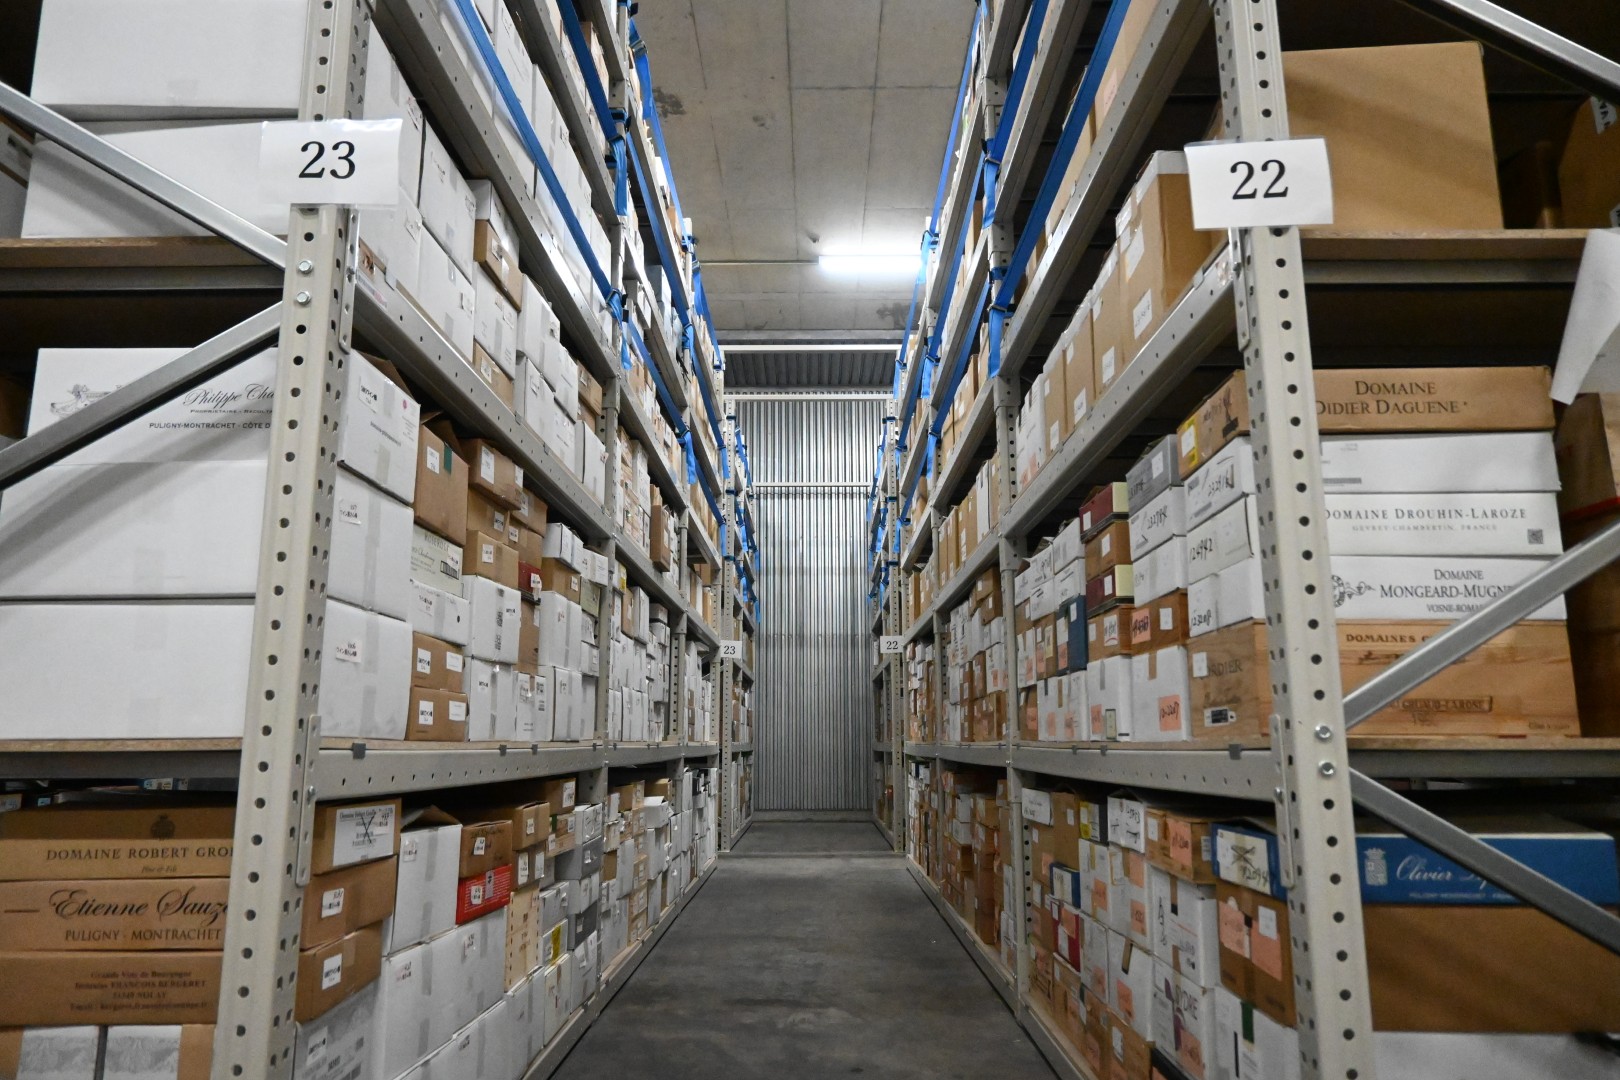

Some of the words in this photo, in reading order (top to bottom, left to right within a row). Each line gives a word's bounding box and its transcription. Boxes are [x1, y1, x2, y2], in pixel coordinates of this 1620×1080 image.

[299, 141, 356, 179] 23
[1229, 159, 1289, 200] 22
[1355, 381, 1436, 395] DOMAINE
[183, 388, 242, 409] Philippe
[1395, 508, 1527, 520] DROUHIN-LAROZE
[1434, 569, 1484, 580] DOMAINE
[886, 641, 898, 650] 22
[1345, 634, 1416, 643] DOMAINES
[724, 646, 735, 655] 23
[46, 848, 121, 861] DOMAINE
[128, 847, 189, 859] ROBERT
[1396, 855, 1453, 881] Olivier
[49, 889, 149, 920] Etienne
[65, 930, 120, 941] PULIGNY
[131, 929, 222, 941] MONTRACHET
